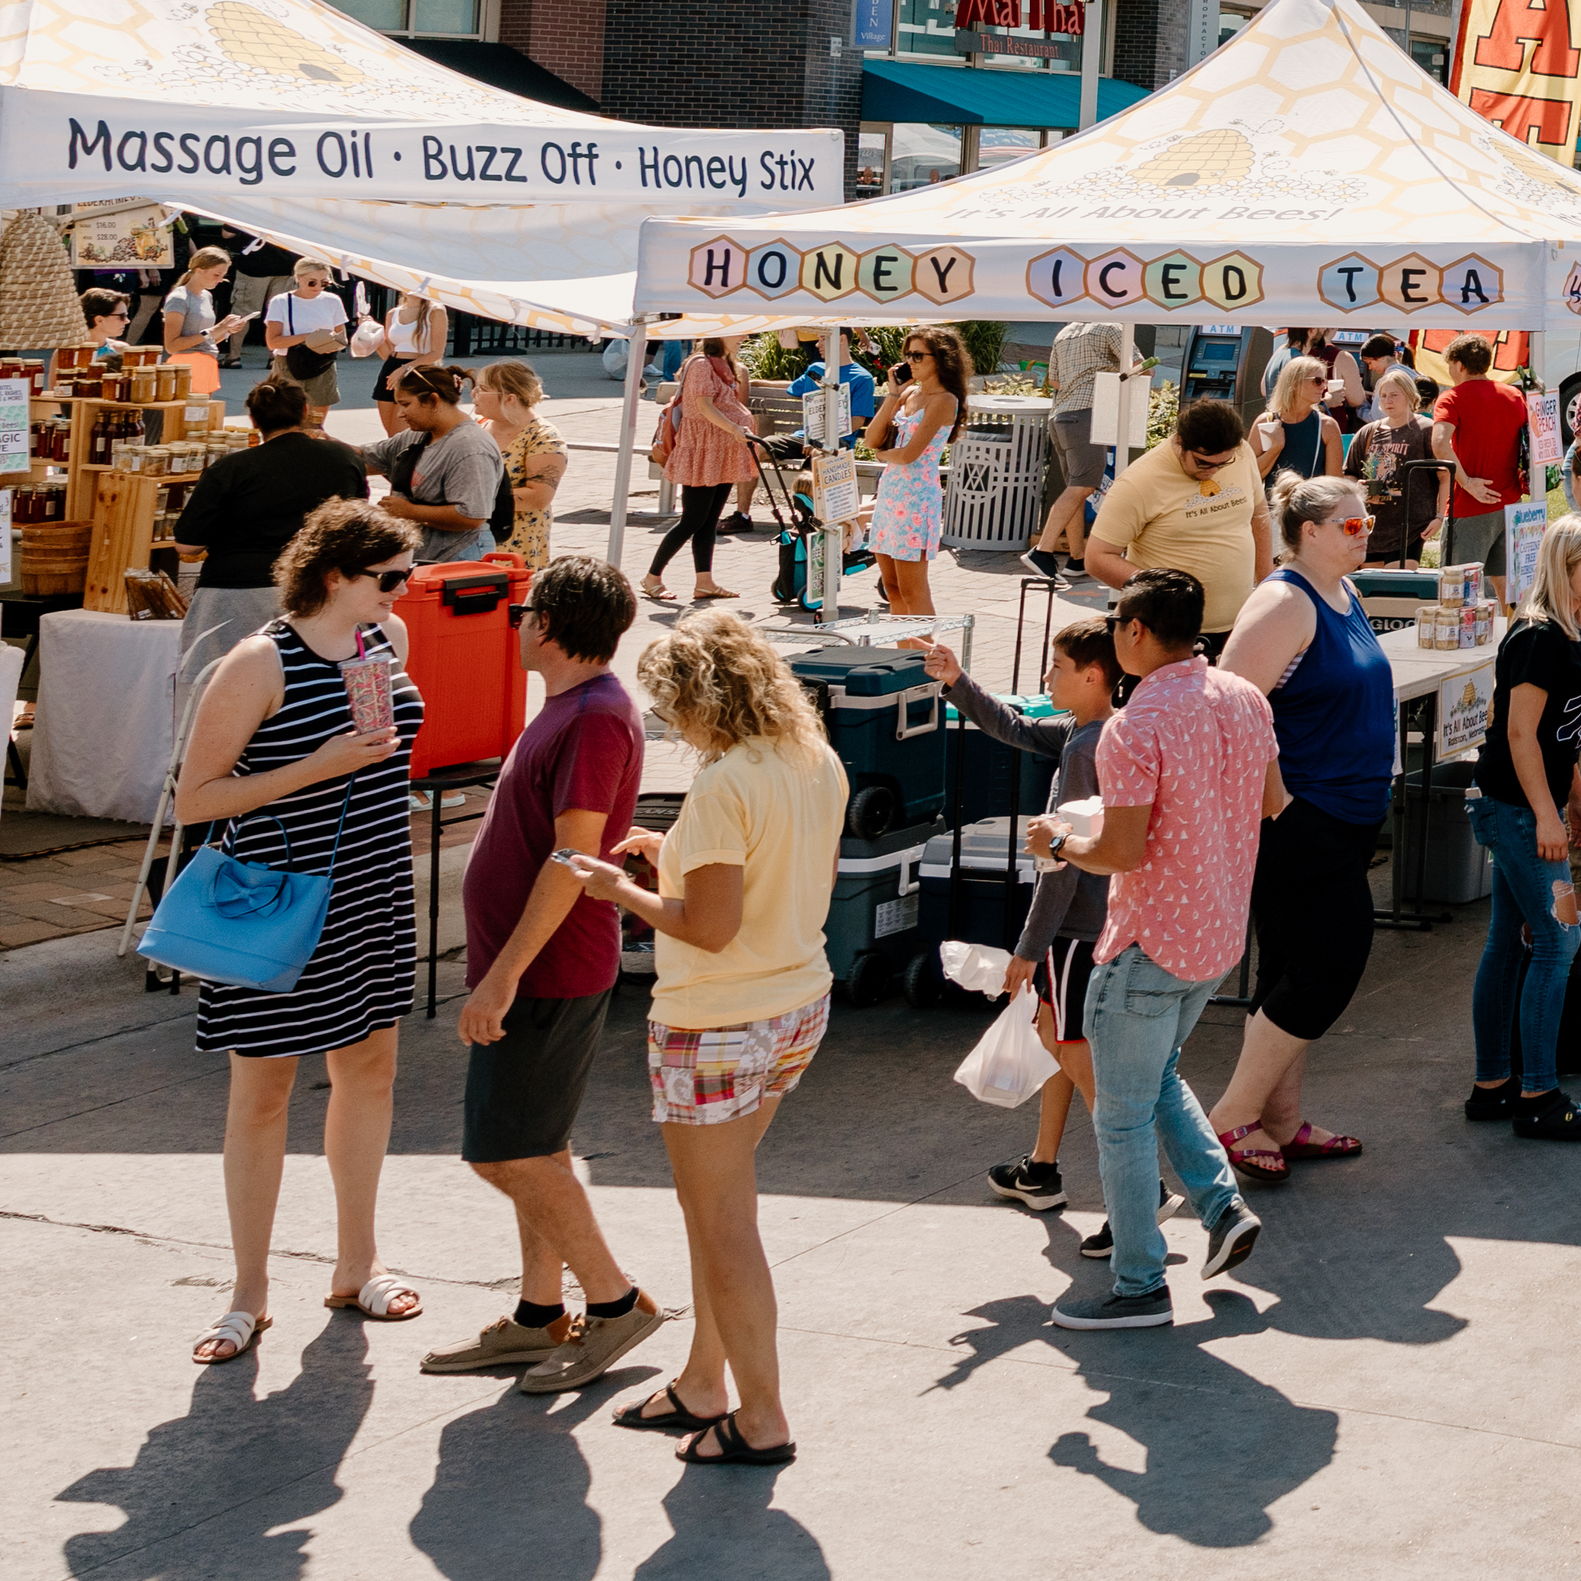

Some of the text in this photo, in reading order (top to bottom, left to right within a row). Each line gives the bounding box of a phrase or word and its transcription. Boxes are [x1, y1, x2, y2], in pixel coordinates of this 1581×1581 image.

[861, 30, 887, 42] Village
[979, 33, 1060, 59] Thai Restaurant
[68, 117, 815, 199] Massage Oil Buzz Off Honey Stix
[943, 205, 1344, 222] It's All About Bees!
[96, 221, 117, 229] $16.00
[96, 233, 118, 241] $28.00
[703, 247, 1490, 304] HONEY ICED TEA
[1210, 324, 1235, 333] ATM
[1338, 331, 1363, 341] ATM
[1535, 399, 1557, 417] GINGER
[1538, 415, 1557, 432] PEACH
[1382, 442, 1410, 456] SPIRIT
[822, 460, 852, 476] HANDMADE
[823, 470, 853, 486] CANDLES
[1185, 509, 1198, 519] It's
[1200, 507, 1208, 516] All
[1210, 502, 1230, 513] About
[1453, 718, 1461, 733] All
[1462, 713, 1478, 731] About
